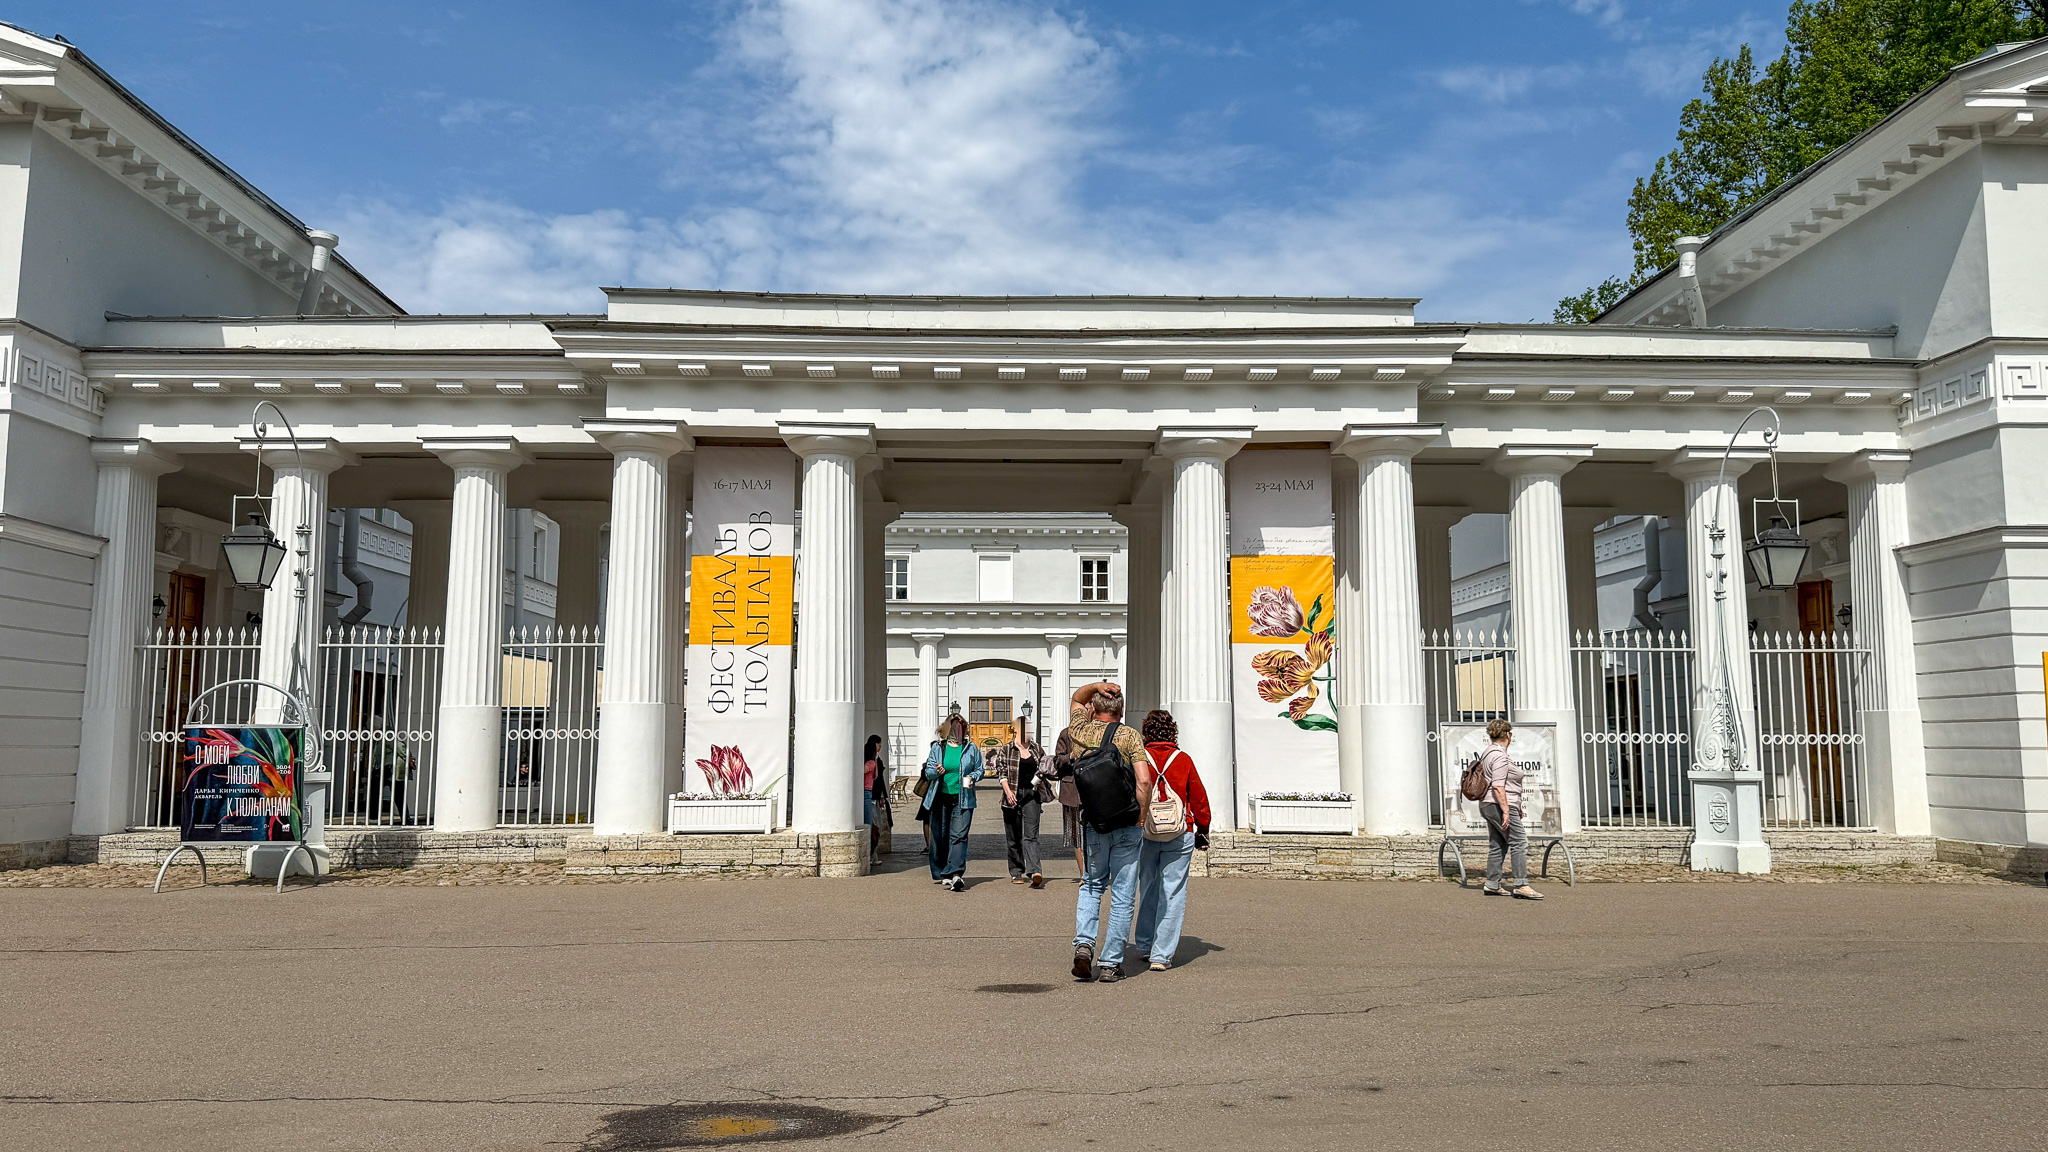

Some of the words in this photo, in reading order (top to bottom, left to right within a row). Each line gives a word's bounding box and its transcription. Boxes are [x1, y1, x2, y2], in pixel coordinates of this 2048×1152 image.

[713, 478, 739, 493] 16-17
[741, 479, 772, 490] МАЯ
[1255, 482, 1281, 493] 23-24
[1284, 479, 1314, 491] МАЯ
[708, 528, 737, 714] ФЕСТИВАЛЬ
[743, 511, 772, 714] ТЮЛЬПАНОВ
[195, 745, 202, 765] О
[204, 741, 230, 765] МОЕЙ
[226, 765, 260, 785] ЛЮБВИ
[226, 797, 233, 817] К
[234, 797, 291, 817] ТЮЛЬПАНАМ
